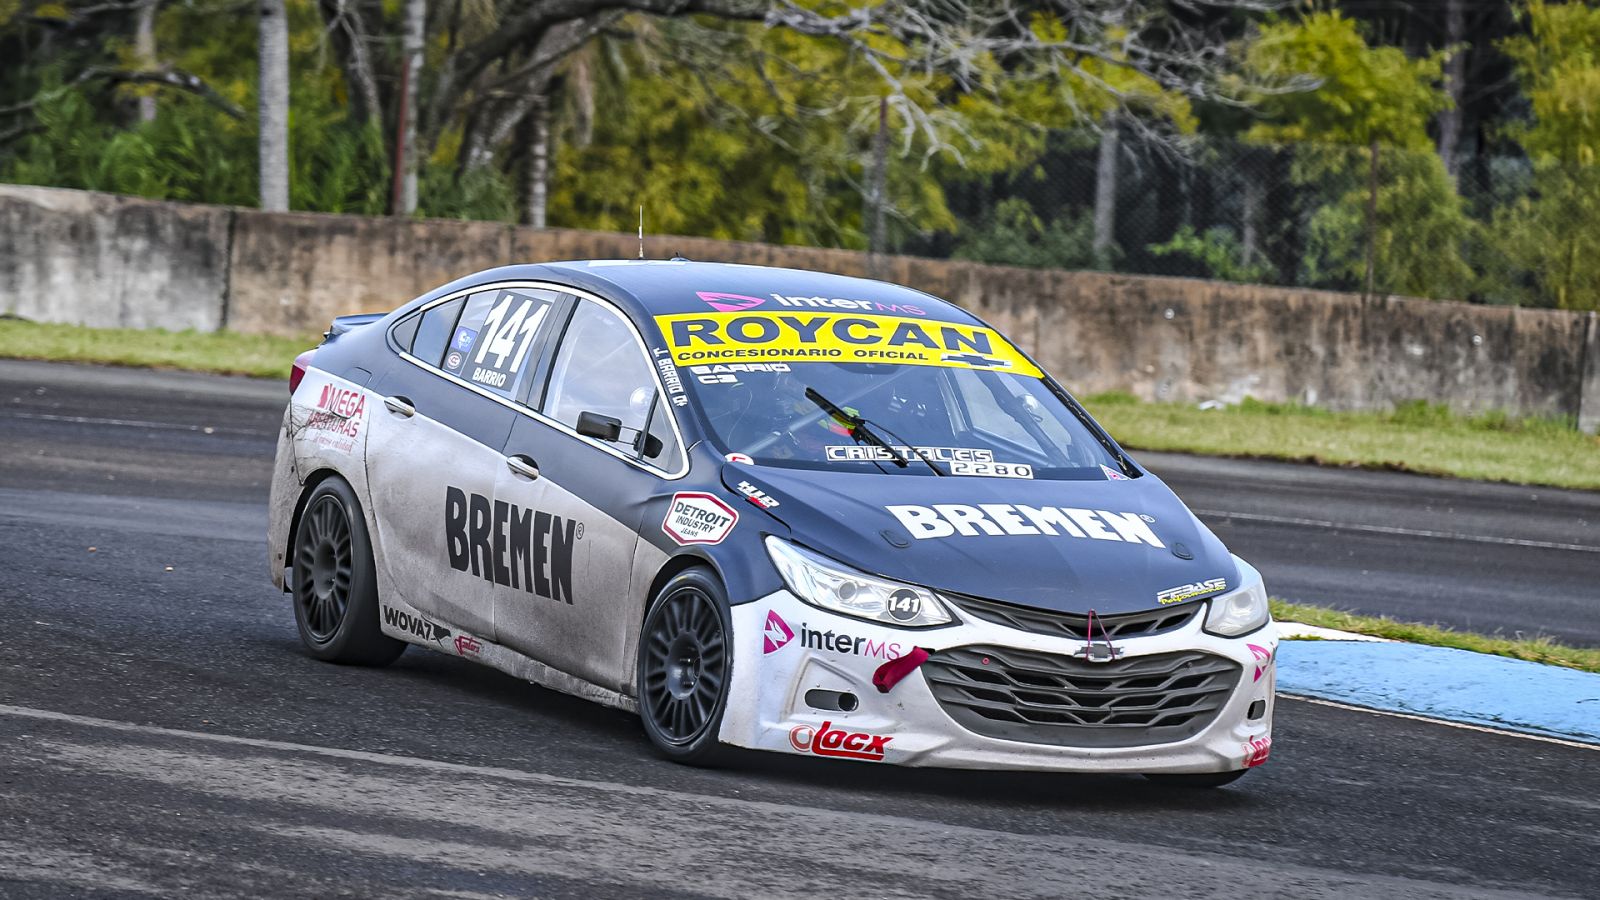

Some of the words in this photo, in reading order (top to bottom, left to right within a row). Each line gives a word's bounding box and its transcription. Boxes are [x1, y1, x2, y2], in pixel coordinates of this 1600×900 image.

[474, 294, 549, 374] 141
[671, 316, 993, 355] ROYCAN
[677, 348, 842, 361] CONCESIONARIO
[854, 350, 929, 360] OFICIAL
[472, 367, 507, 387] BARRIO
[658, 358, 684, 395] BARRIO
[690, 363, 791, 375] BARRIO
[327, 384, 365, 419] MEGA
[955, 461, 1031, 477] 2280
[674, 501, 730, 528] DETROIT
[675, 515, 716, 533] INDUSTRY
[680, 527, 699, 538] JEANS
[888, 596, 921, 613] 141
[800, 622, 901, 660] interMS
